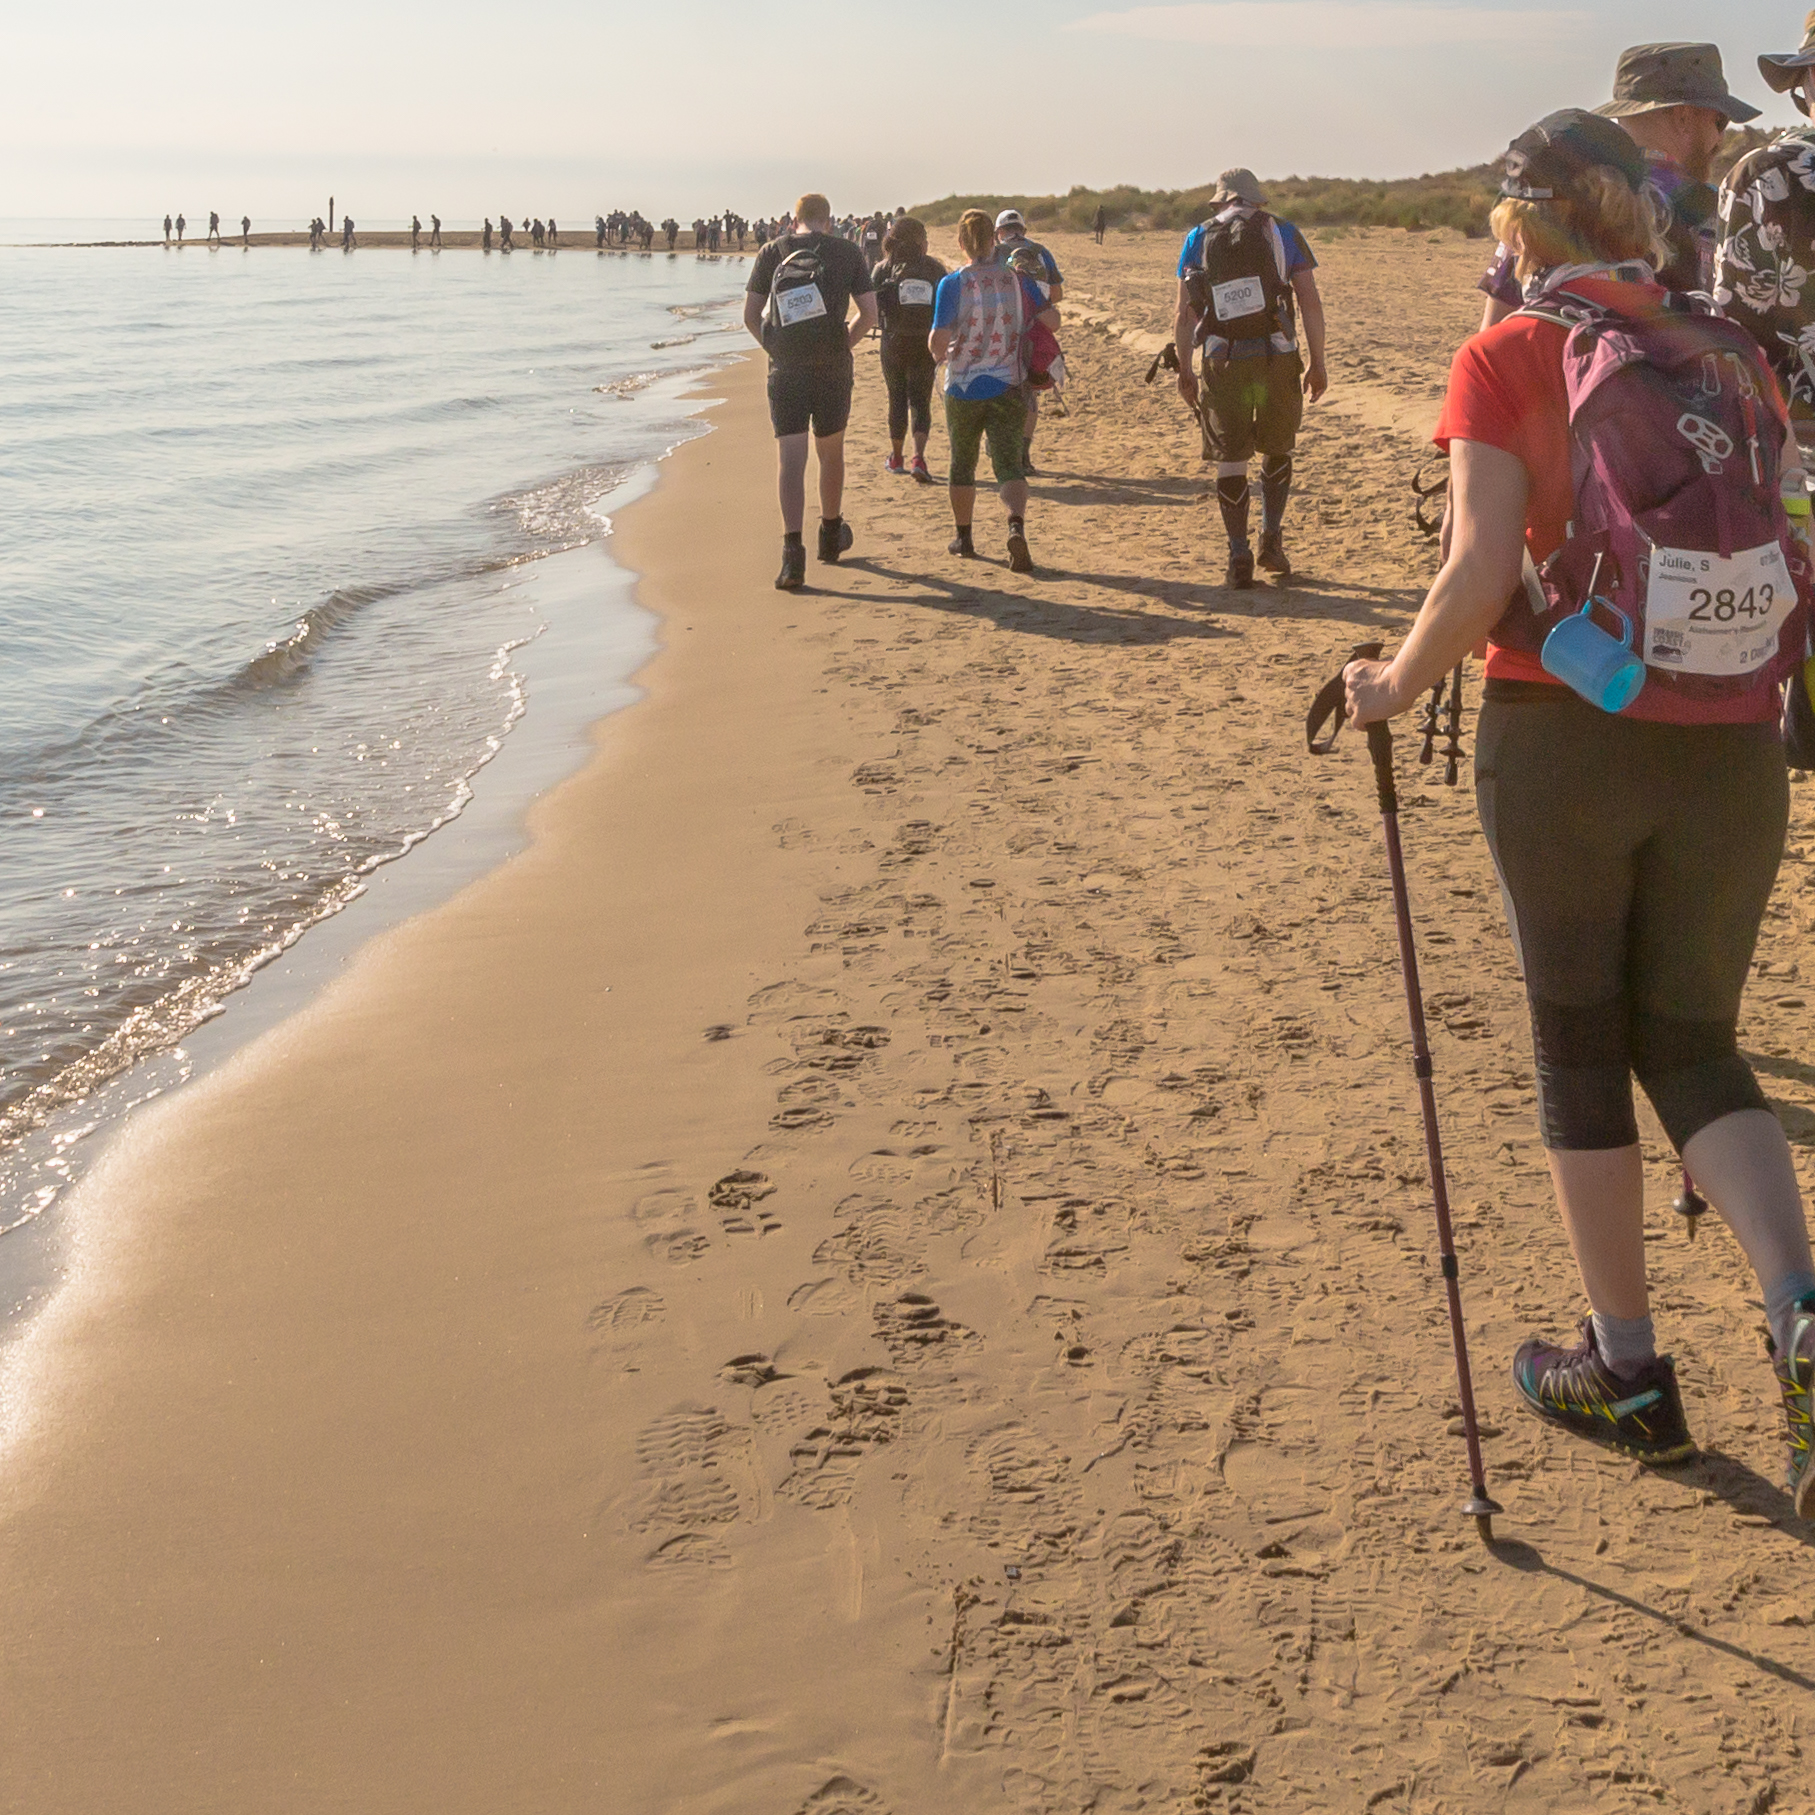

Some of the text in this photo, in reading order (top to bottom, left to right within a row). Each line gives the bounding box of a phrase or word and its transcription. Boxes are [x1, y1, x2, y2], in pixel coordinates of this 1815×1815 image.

[787, 293, 813, 309] 5203
[1224, 287, 1252, 303] 5200
[1659, 555, 1710, 572] Julie, S
[1688, 583, 1774, 622] 2843
[1739, 651, 1748, 664] 2
